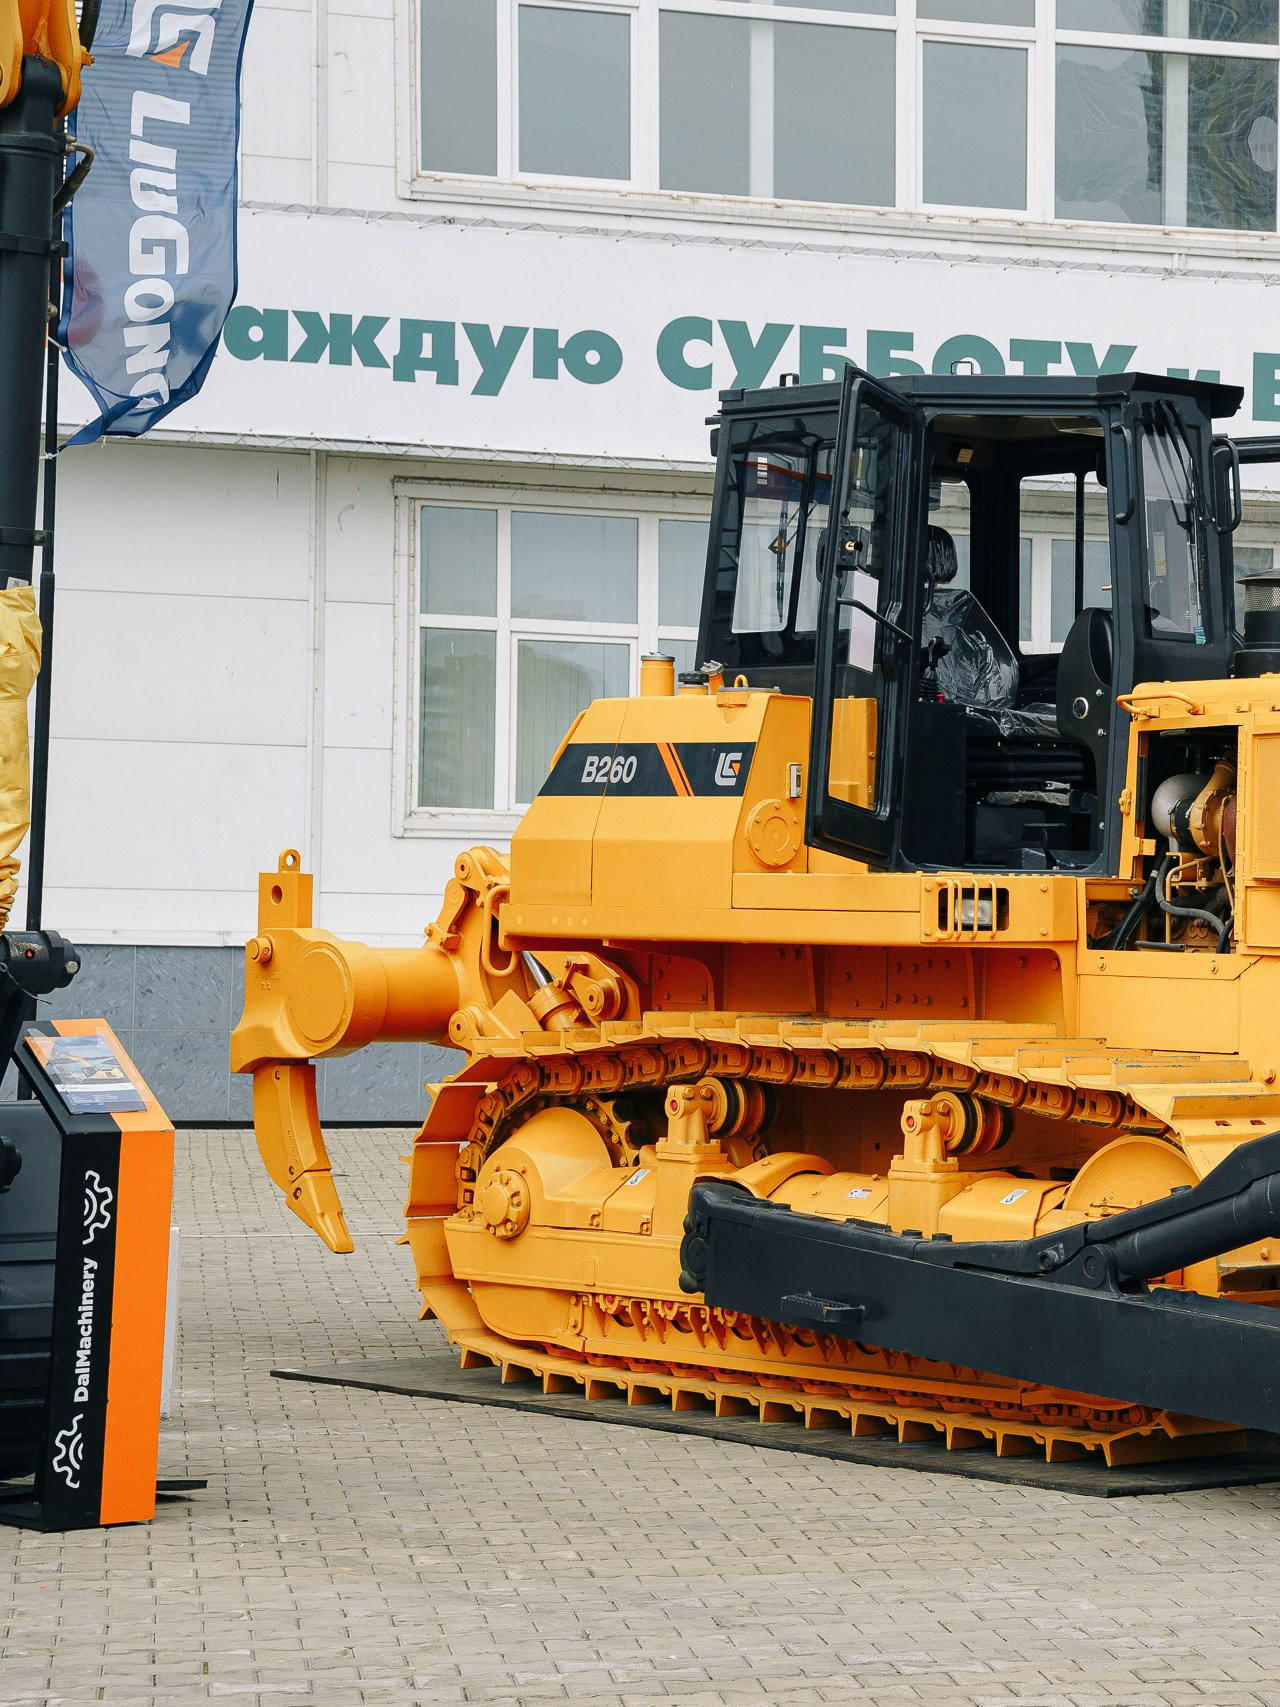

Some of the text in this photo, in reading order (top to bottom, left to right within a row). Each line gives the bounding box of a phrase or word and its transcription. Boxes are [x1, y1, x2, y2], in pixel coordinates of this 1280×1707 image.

[215, 305, 623, 396] аждую
[581, 755, 638, 784] B260
[74, 1257, 98, 1402] DalMachinery
